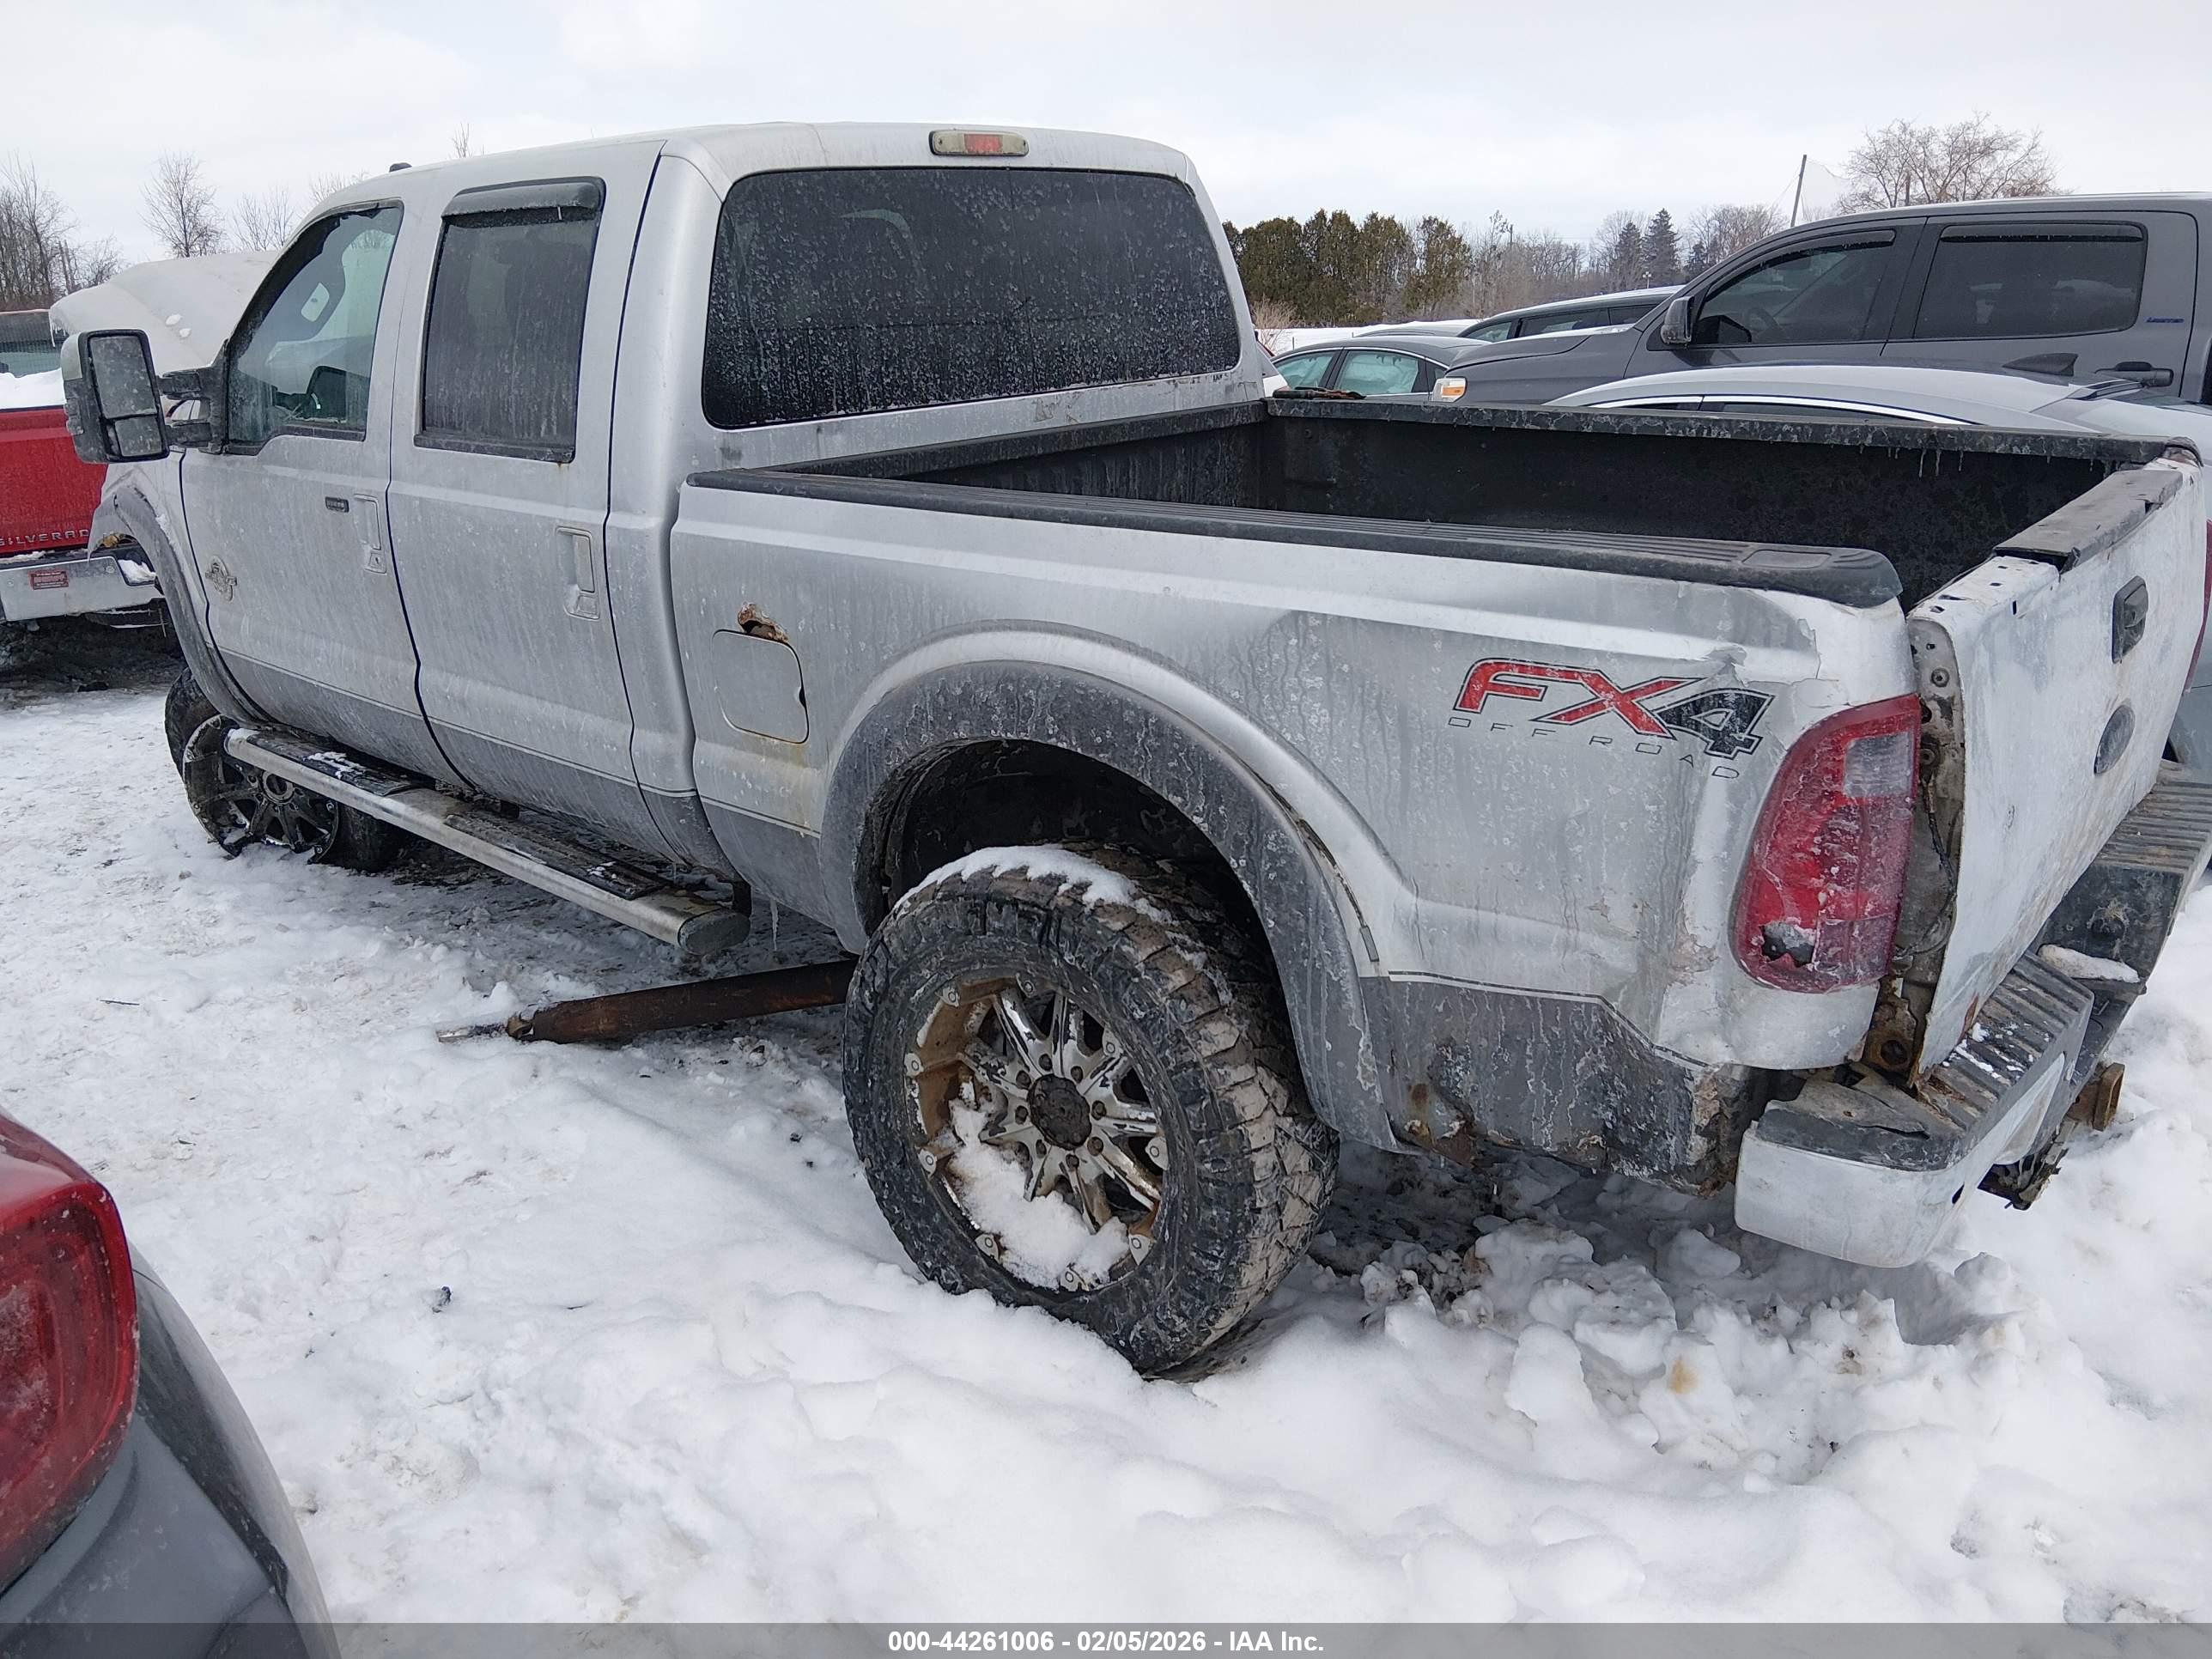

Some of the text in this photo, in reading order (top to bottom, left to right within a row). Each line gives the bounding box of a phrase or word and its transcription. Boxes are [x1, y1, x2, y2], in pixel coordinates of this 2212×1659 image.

[1447, 716, 1741, 780] OFF ROAD
[1452, 657, 1776, 760] FX4
